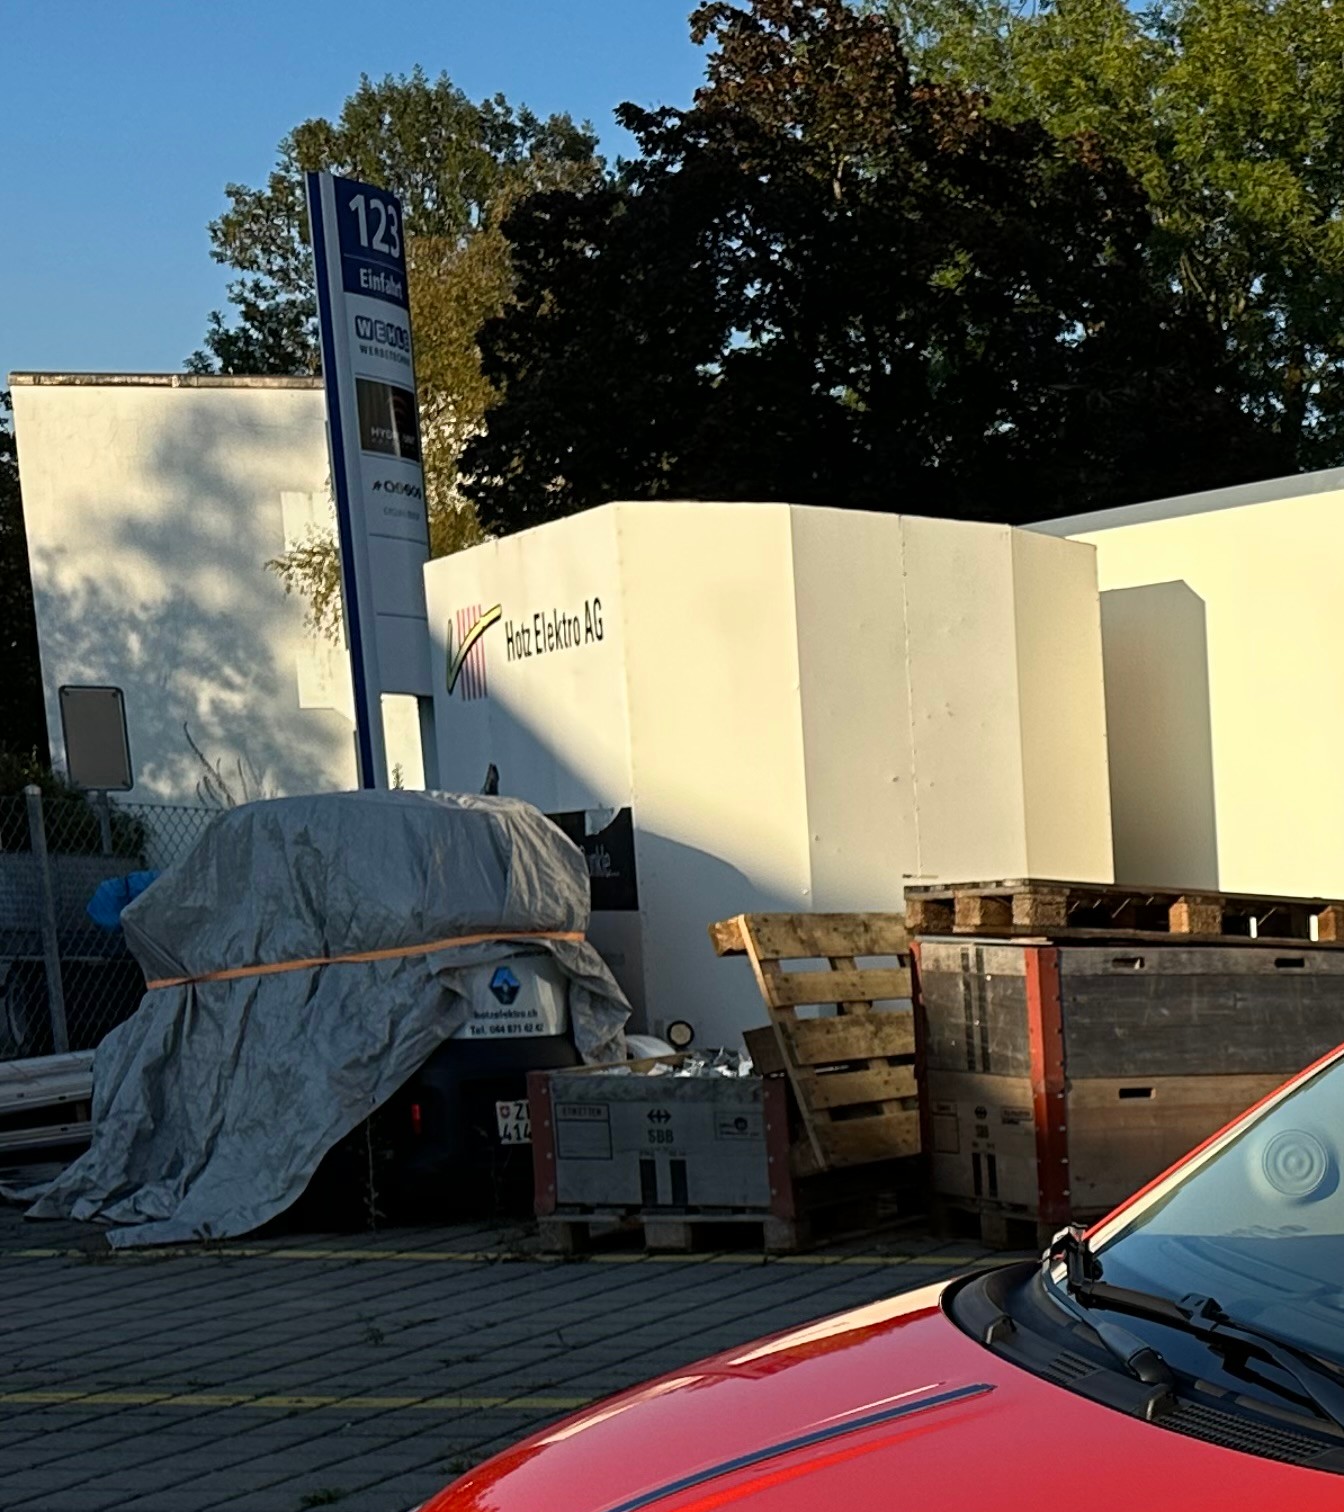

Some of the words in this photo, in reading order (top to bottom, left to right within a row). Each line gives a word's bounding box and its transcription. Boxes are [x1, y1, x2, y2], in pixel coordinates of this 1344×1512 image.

[348, 194, 400, 258] 123
[505, 619, 532, 662] Hotz
[533, 607, 580, 655] Elektro
[584, 596, 603, 645] AG
[647, 1128, 674, 1144] SBB
